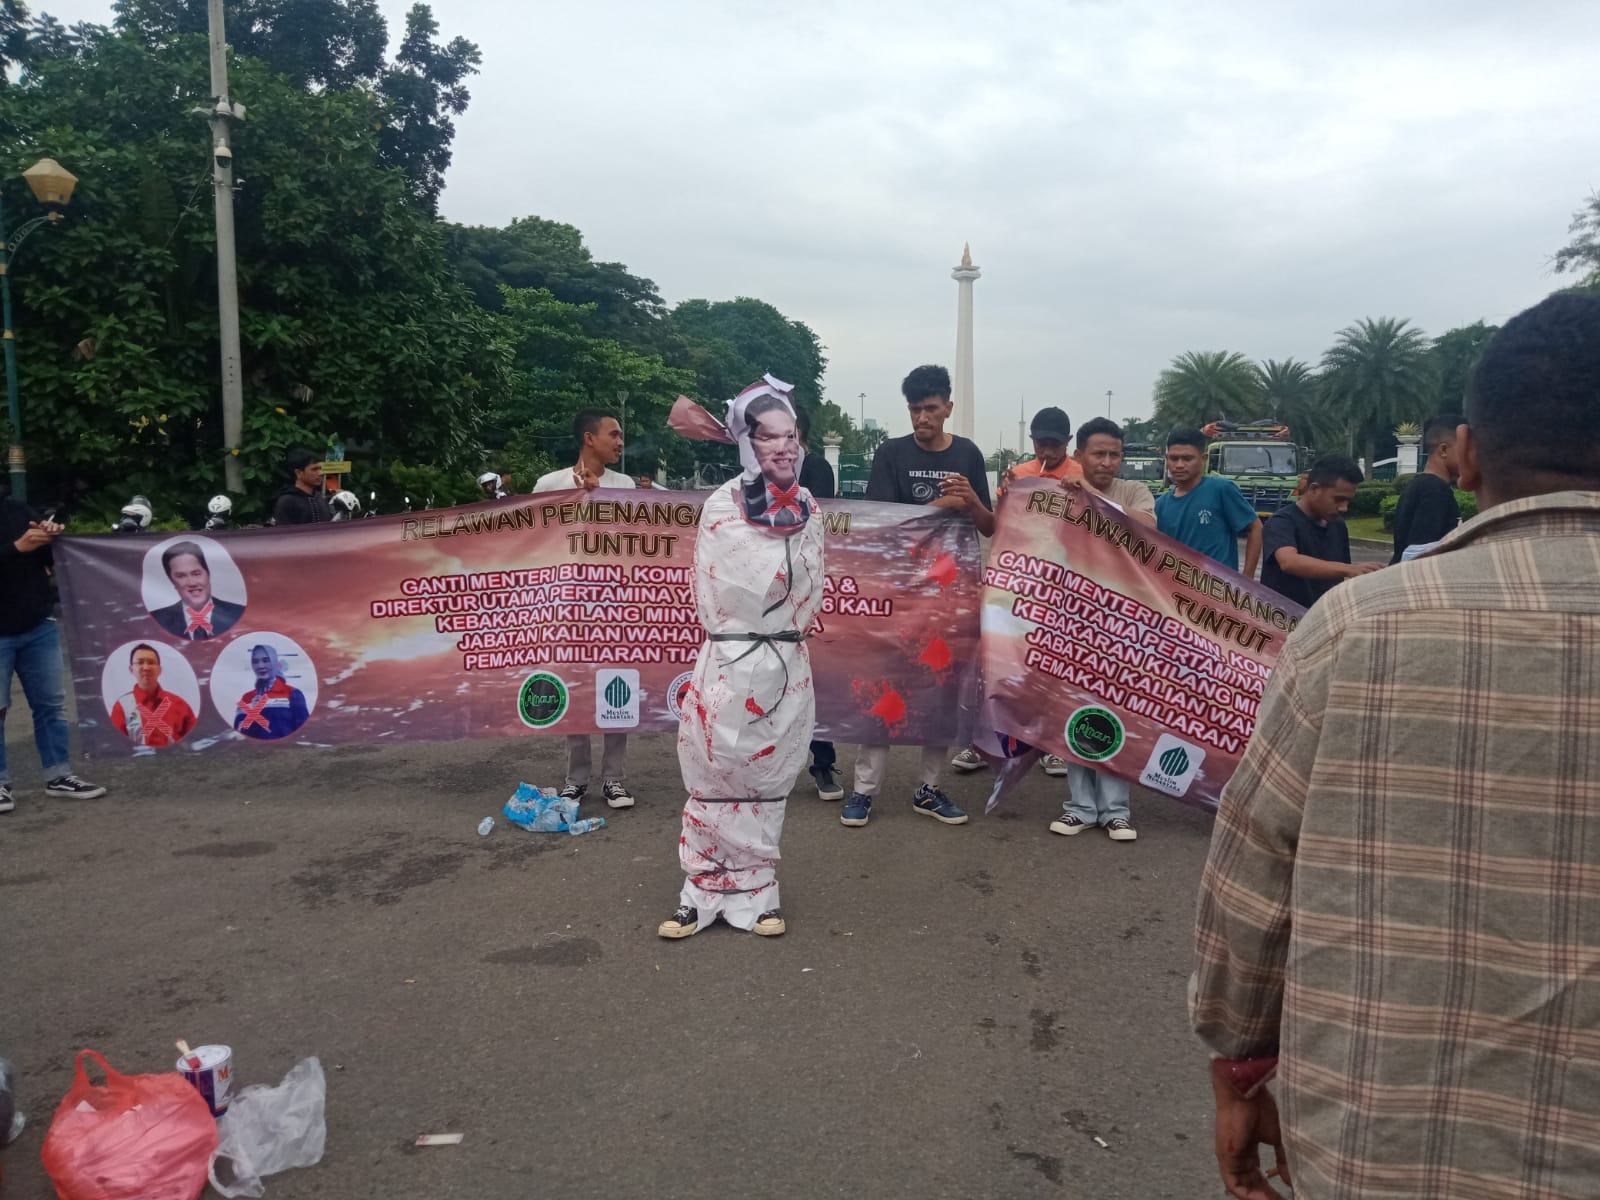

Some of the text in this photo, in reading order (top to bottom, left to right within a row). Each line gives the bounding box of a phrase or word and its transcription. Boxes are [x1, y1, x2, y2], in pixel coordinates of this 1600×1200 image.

[908, 470, 960, 479] UNLIMI
[402, 506, 535, 541] RELAWAN
[823, 512, 851, 535] WI
[566, 531, 679, 558] TUNTUT
[1026, 490, 1299, 634] RELAWAN PEMENANGA
[402, 564, 857, 595] GANTI MENTERI BUMN, KOMI A &
[372, 594, 478, 617] DIREKTUR
[482, 588, 546, 609] UTAMA
[550, 584, 674, 604] PERTAMINA
[675, 588, 692, 604] Y
[838, 597, 892, 615] KALI
[436, 605, 553, 632] KEBAKARAN
[557, 604, 641, 623] KILANG
[645, 607, 701, 624] MINY
[999, 552, 1063, 584] GANTI
[1064, 570, 1161, 629] MENTERI
[1229, 651, 1272, 680] KOM
[458, 624, 701, 649] JABATAN KALIAN WAHAI
[984, 568, 1264, 699] REKTUR UTAMA PERTAMINA
[1171, 591, 1273, 656] TUNTUT
[465, 646, 699, 670] PEMAKAN MILIARAN TIA
[1013, 598, 1258, 719] KEBAKARAN KILANG MI
[1025, 627, 1255, 737] JABATAN KALIAN WAH
[1026, 648, 1126, 705] PEMAKAN
[1124, 693, 1239, 755] MILIARAN
